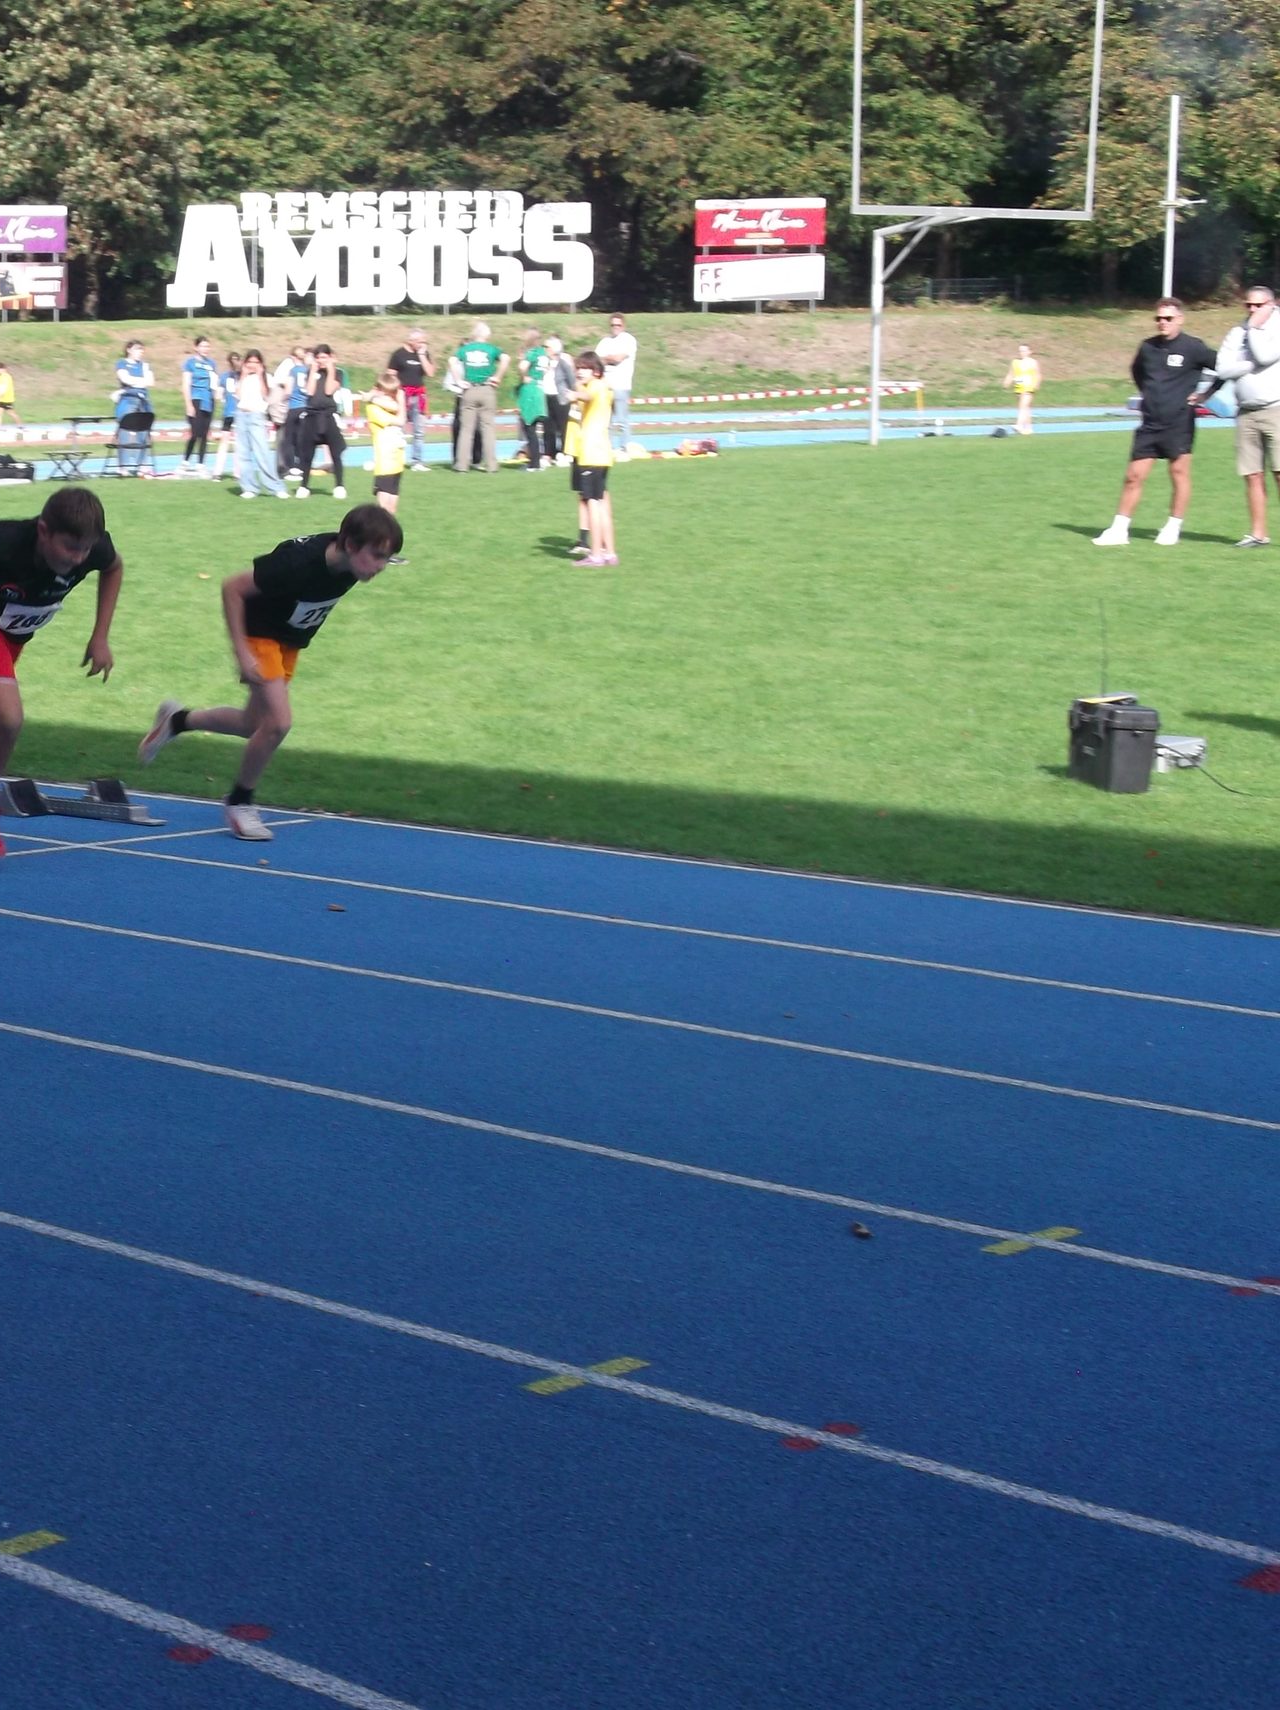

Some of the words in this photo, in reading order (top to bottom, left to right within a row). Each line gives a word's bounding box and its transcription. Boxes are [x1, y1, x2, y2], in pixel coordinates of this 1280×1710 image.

[239, 190, 525, 230] REMSCHEID
[166, 201, 594, 308] AMBOSS
[297, 605, 332, 624] 27
